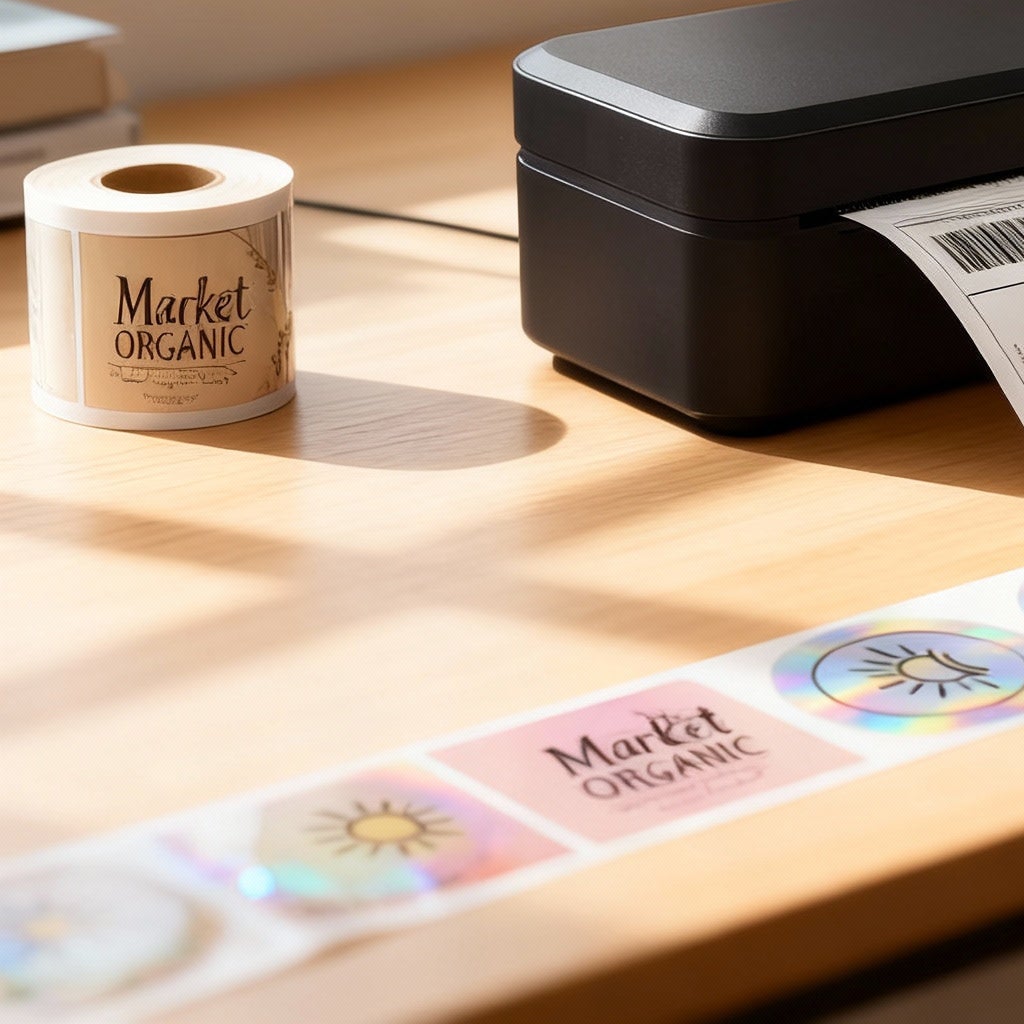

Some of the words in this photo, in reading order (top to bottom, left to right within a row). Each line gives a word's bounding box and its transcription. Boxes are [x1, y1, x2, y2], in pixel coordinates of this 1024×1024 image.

[113, 275, 252, 326] Market
[115, 325, 247, 361] ORGANIC
[582, 734, 768, 800] ORGANIC
